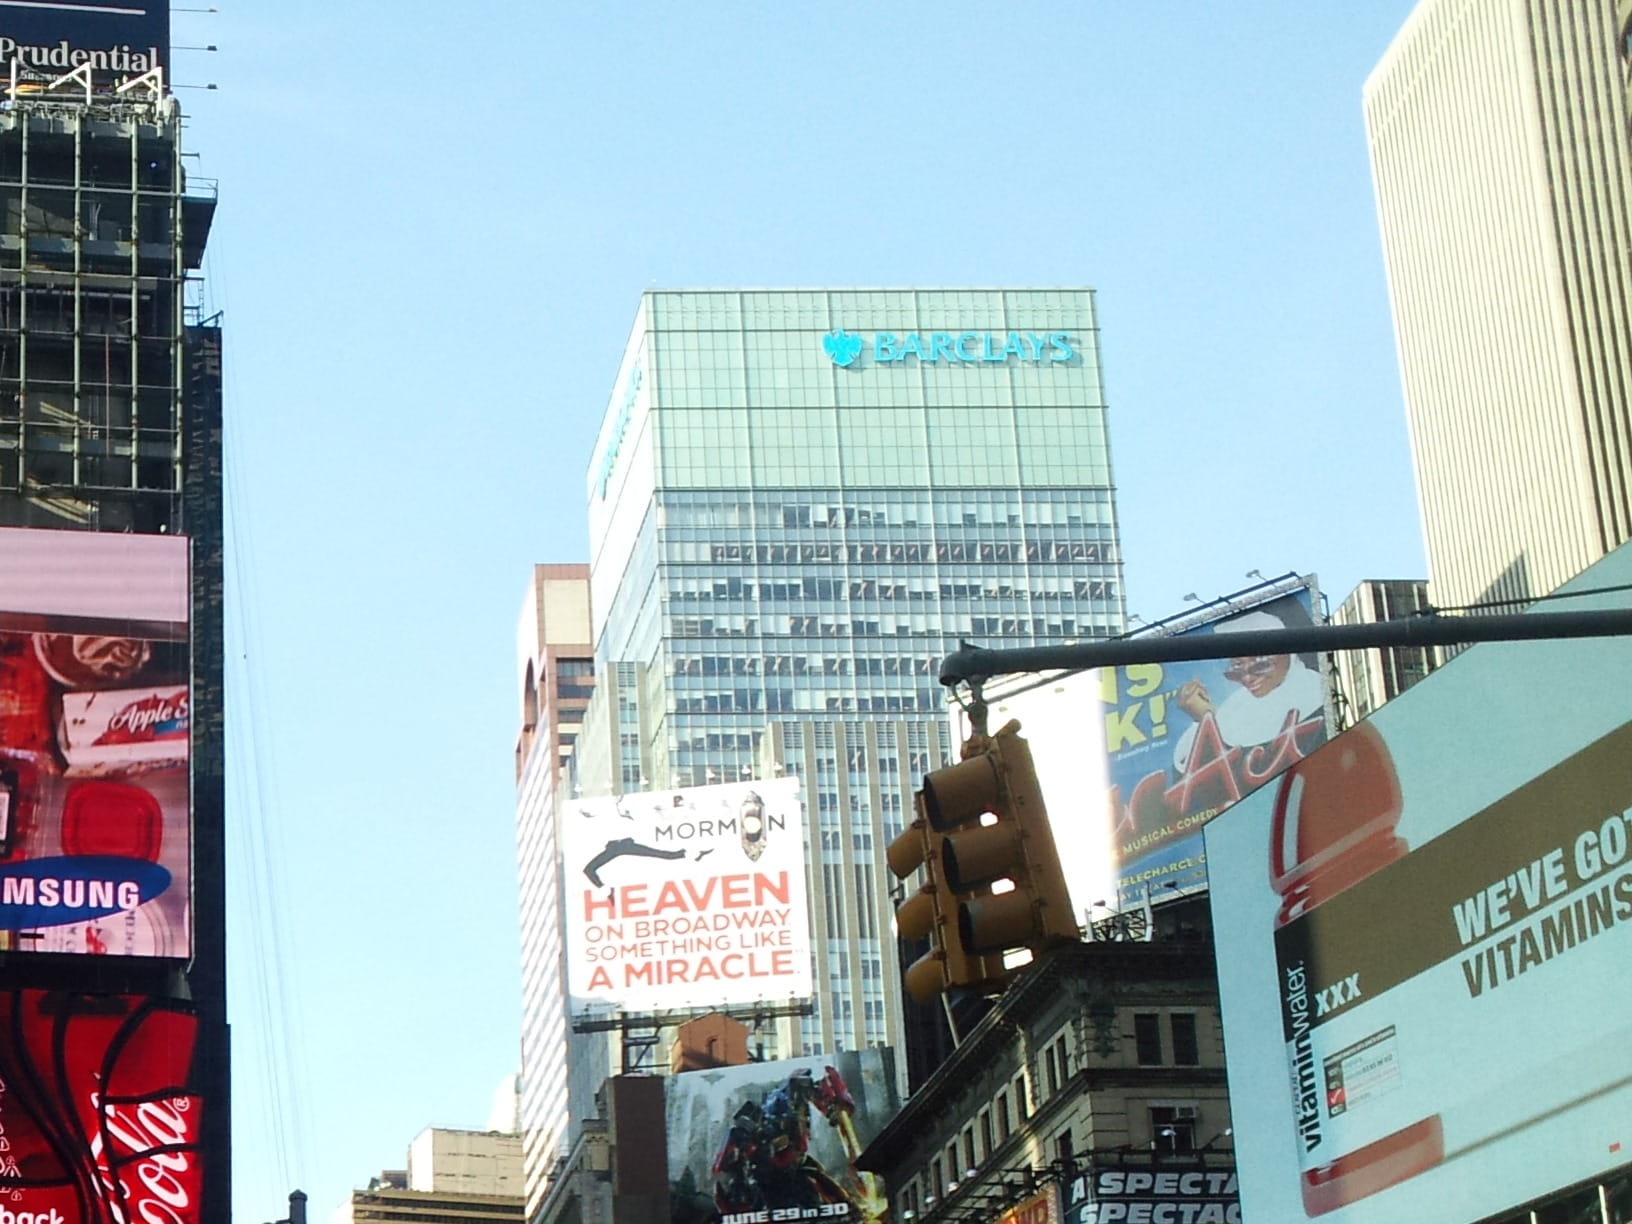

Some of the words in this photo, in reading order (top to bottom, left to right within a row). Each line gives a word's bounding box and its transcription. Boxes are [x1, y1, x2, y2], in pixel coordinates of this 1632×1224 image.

[874, 332, 1074, 362] BARCLAYS
[111, 700, 173, 736] Apple
[1123, 826, 1172, 856] MUSICAL
[1177, 805, 1219, 831] COMEDY
[584, 870, 790, 922] HEAVEN
[1453, 847, 1568, 945] WE'VE
[586, 925, 625, 944] ON
[635, 908, 791, 938] BROADWAY
[1462, 872, 1632, 998] VITAMINS
[586, 935, 731, 962] SOMETHING
[740, 930, 792, 948] LIKE
[587, 965, 614, 991] A
[1070, 1176, 1086, 1204] A
[772, 1207, 801, 1222] 29
[819, 1202, 849, 1217] 3D
